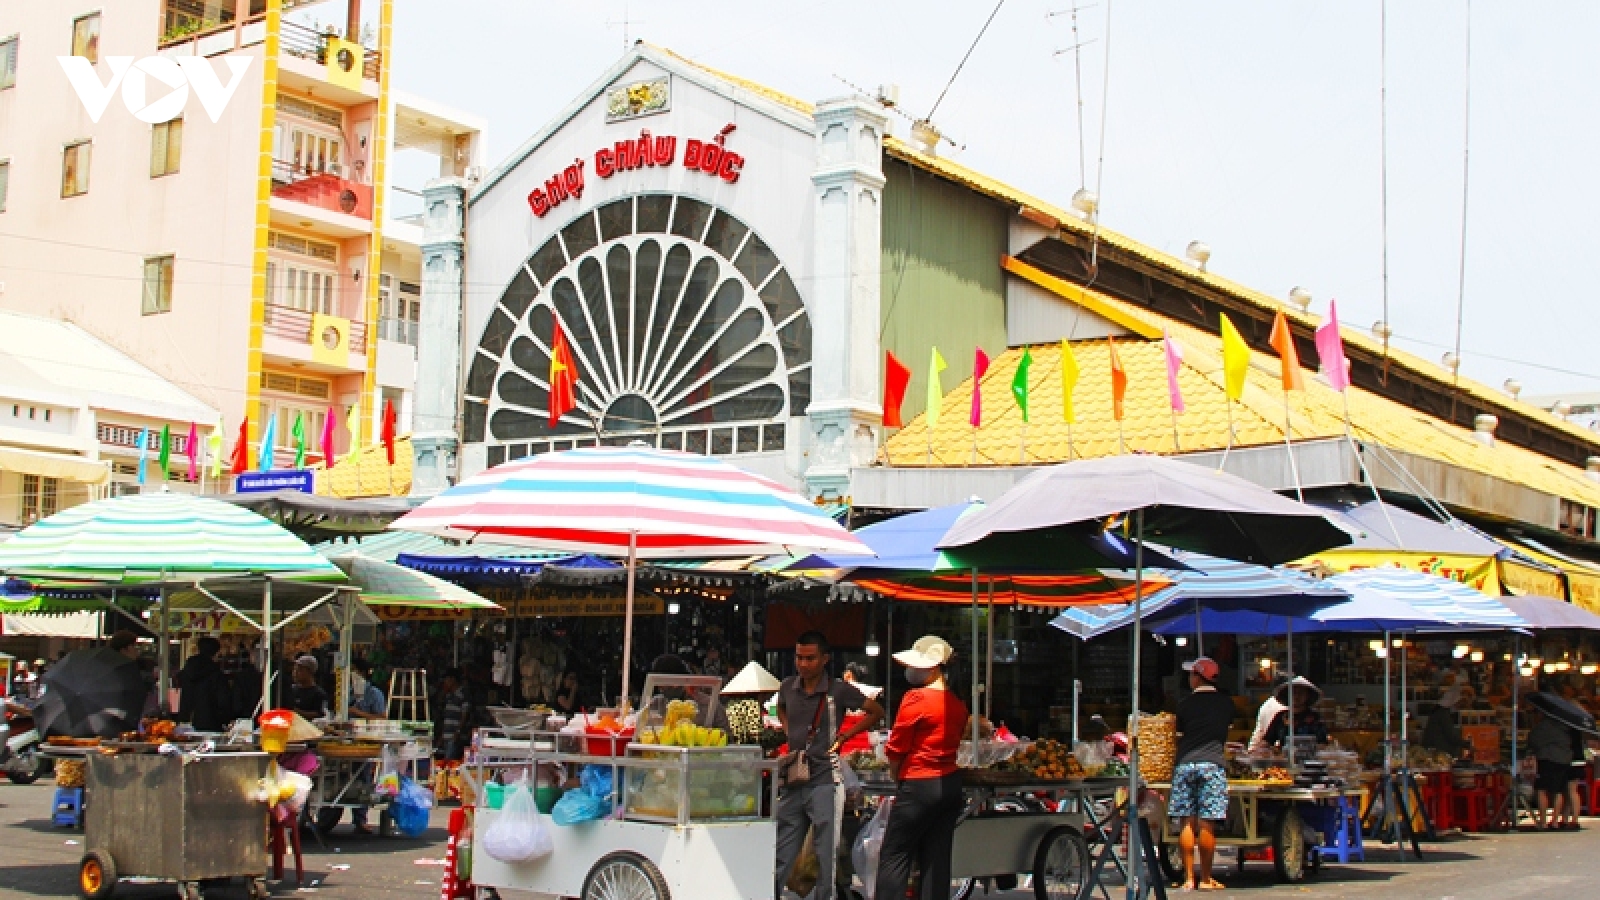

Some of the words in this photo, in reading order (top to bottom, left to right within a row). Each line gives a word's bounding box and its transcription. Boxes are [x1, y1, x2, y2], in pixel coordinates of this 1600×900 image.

[527, 158, 585, 218] CHỢ
[594, 128, 677, 179] CHÂU
[683, 122, 745, 184] ĐỐC
